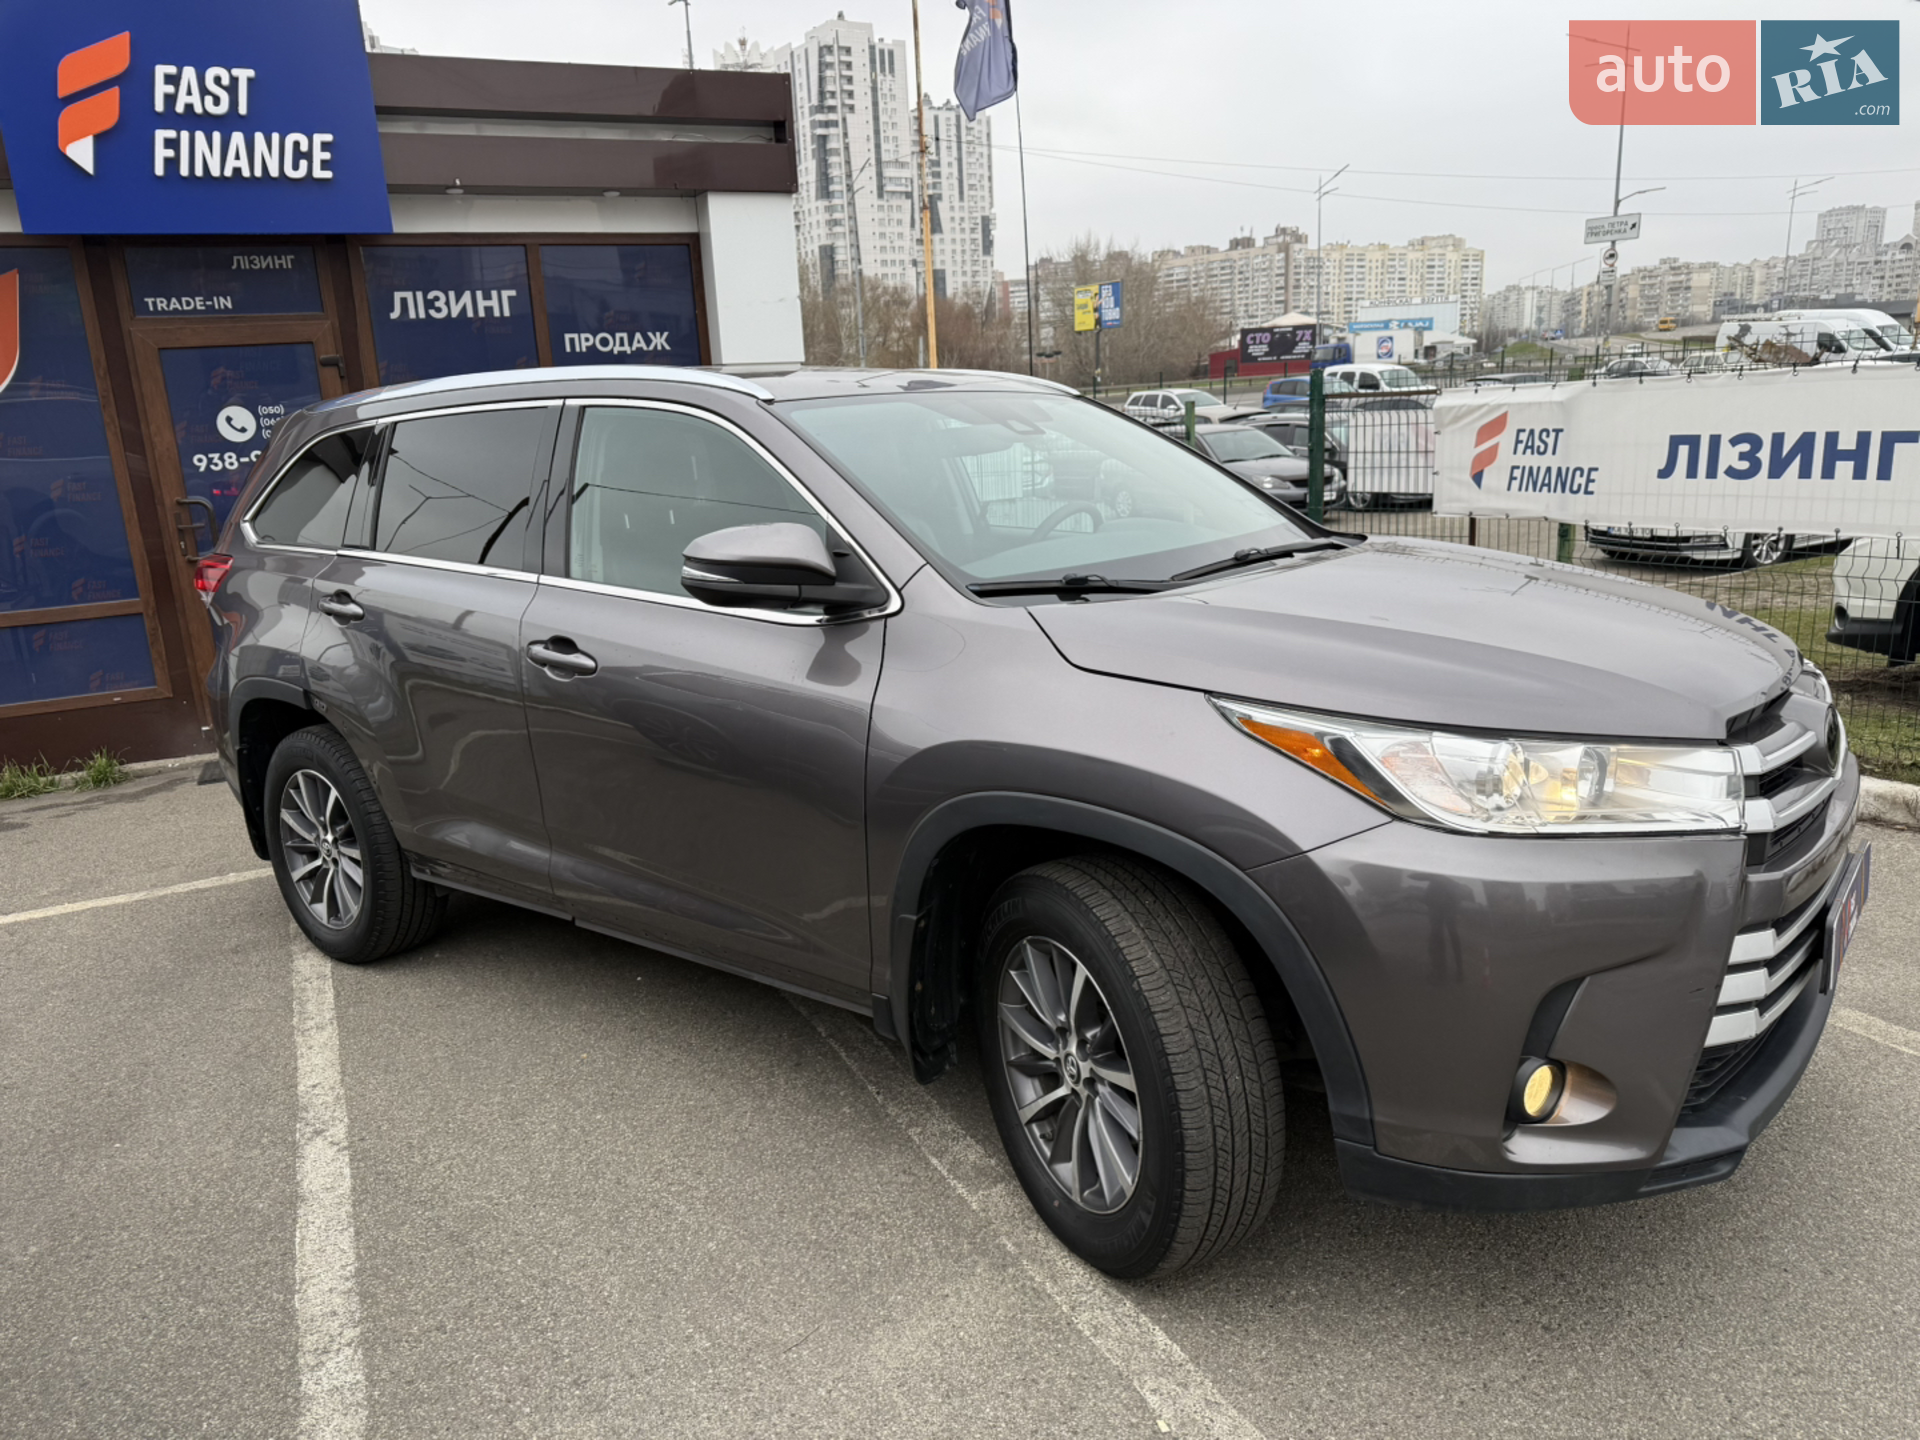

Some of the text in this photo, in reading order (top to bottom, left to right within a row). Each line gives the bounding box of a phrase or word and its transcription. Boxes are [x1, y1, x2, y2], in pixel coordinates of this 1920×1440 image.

[153, 64, 256, 116] FAST
[153, 129, 334, 180] FINANCE
[1608, 220, 1628, 229] ПЕТРА
[231, 254, 295, 270] ЛІЗИНГ
[144, 295, 233, 313] TRADE-IN
[390, 290, 517, 320] ЛІЗИНГ
[564, 331, 671, 354] ПРОДАЖ
[1246, 332, 1271, 345] СТО
[258, 404, 284, 416] (050)
[260, 416, 285, 428] (06
[1512, 428, 1564, 456] FAST
[1656, 431, 1920, 481] ЛІЗИНГ
[1506, 466, 1599, 496] FINANCE
